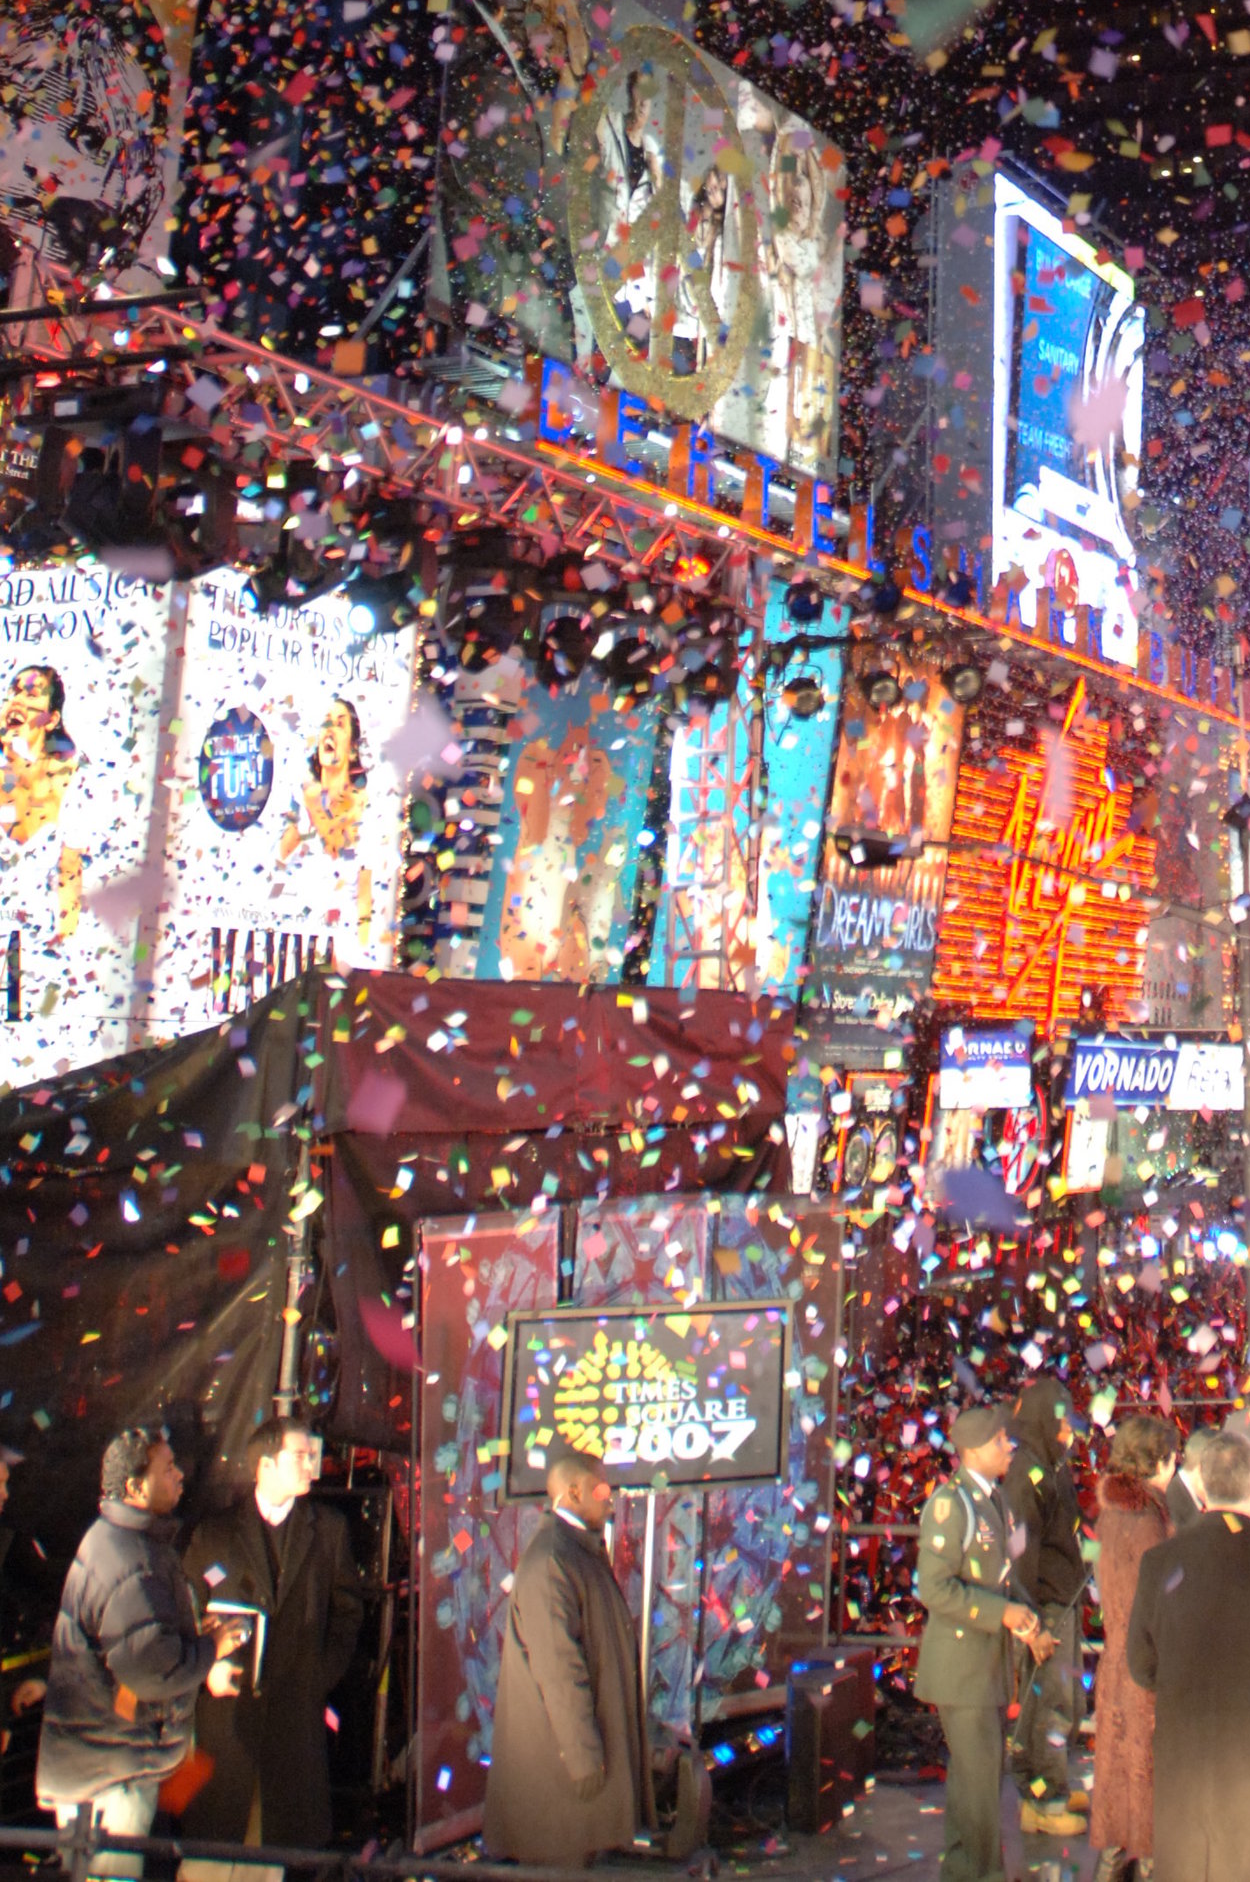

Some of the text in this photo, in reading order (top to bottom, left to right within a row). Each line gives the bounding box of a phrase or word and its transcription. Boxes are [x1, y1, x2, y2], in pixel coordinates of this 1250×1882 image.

[1038, 338, 1080, 376] SANITARY
[11, 450, 38, 469] THE
[1074, 1051, 1172, 1095] VORNADO
[612, 1379, 698, 1405] TIMES
[626, 1398, 748, 1428] SQUARE
[602, 1419, 757, 1465] 2007
